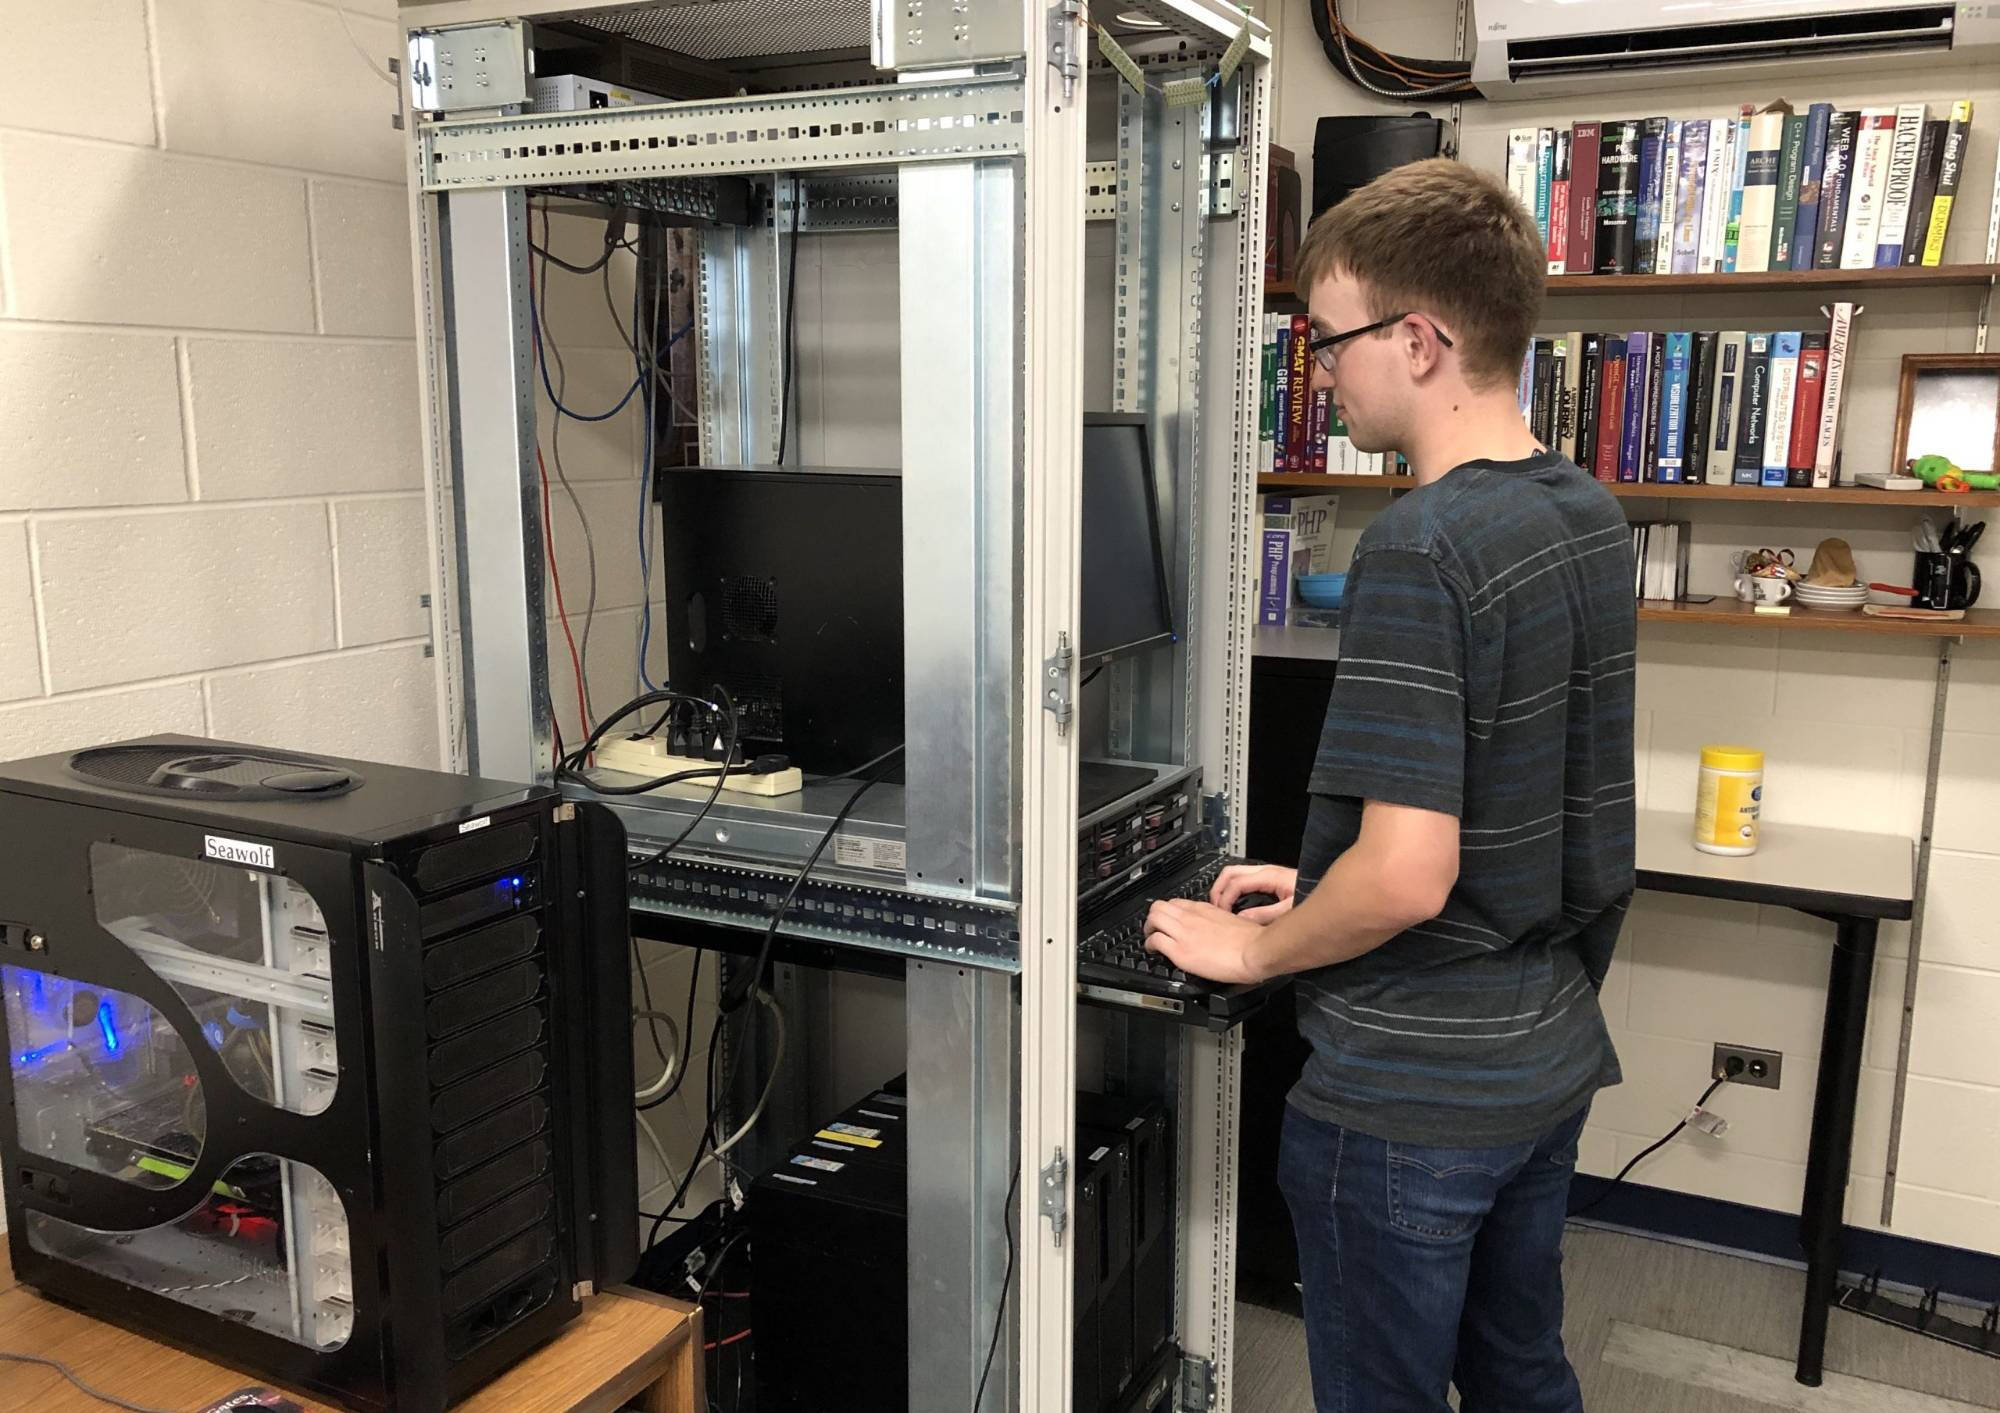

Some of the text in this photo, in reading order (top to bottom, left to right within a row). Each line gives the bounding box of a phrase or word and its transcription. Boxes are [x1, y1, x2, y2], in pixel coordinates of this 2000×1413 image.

[1577, 128, 1595, 138] IBM
[1794, 122, 1802, 138] C++
[1602, 154, 1638, 164] HARDWARE
[1788, 141, 1800, 173] Program
[1942, 133, 1962, 185] Feng Shui
[1537, 152, 1550, 218] Programming
[1786, 175, 1797, 200] Design
[1830, 127, 1851, 233] WEB 2.0 FUNDAMENTALS
[1276, 369, 1288, 391] GRE
[1292, 336, 1305, 424] GMAT REVIEW
[1612, 355, 1621, 384] OpenGL
[1752, 366, 1764, 405] Computer
[1650, 369, 1659, 425] INCOMPREHENSIBLE
[1668, 383, 1681, 430] VISUALIZATION
[1779, 368, 1791, 422] DISTRIBUTED
[1826, 371, 1839, 413] HISTORIC
[1561, 387, 1571, 439] JOURNEY
[1748, 407, 1761, 444] Networks
[1667, 432, 1677, 457] TOOLKIT
[1774, 424, 1785, 463] SYSTEMS
[1823, 415, 1833, 447] PLACES
[1297, 509, 1327, 536] PHP
[1268, 541, 1284, 560] PHP
[207, 838, 271, 866] Seawolf
